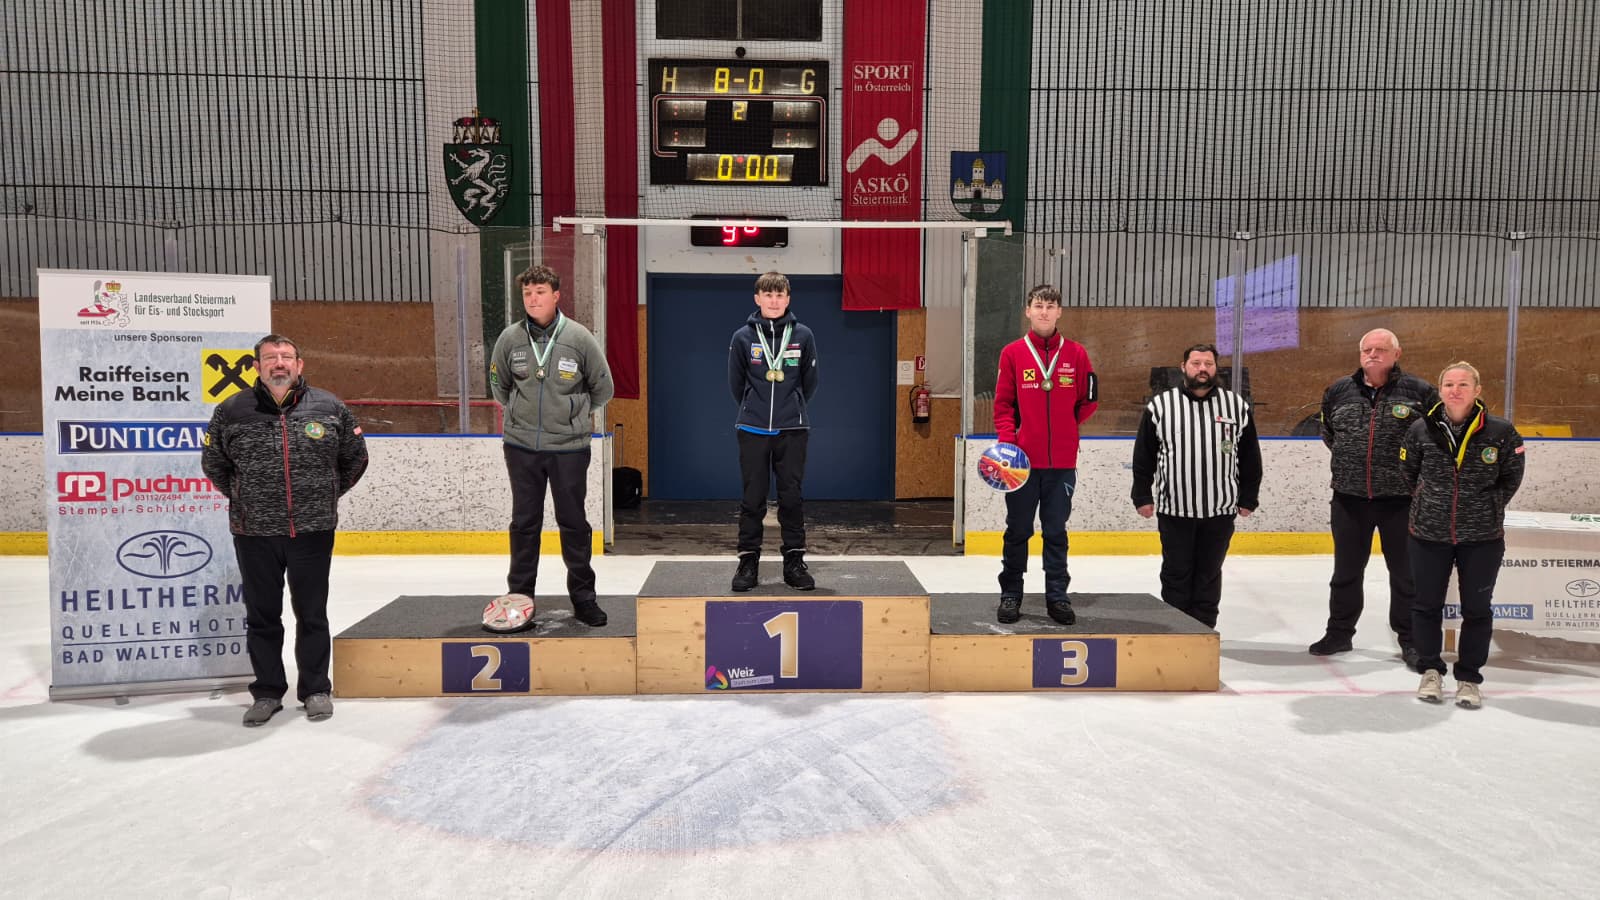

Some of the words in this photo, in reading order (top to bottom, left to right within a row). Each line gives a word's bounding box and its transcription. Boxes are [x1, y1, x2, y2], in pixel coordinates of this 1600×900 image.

[662, 67, 677, 92] H
[801, 69, 816, 94] G
[854, 65, 912, 80] SPORT
[854, 83, 862, 92] in
[866, 82, 910, 92] Österreich
[733, 102, 745, 120] 2
[853, 174, 909, 193] ASKÖ
[853, 194, 909, 205] Steiermark
[134, 292, 192, 304] Landesverband
[194, 294, 236, 305] Steiermark
[135, 305, 147, 316] für
[149, 306, 164, 316] Eis-
[167, 307, 181, 316] und
[183, 307, 224, 318] Stocksport
[114, 334, 147, 342] unsere
[150, 333, 202, 344] Sponsoren
[79, 366, 190, 383] Raiffeisen
[55, 386, 124, 401] Meine
[132, 386, 190, 402] Bank
[63, 650, 104, 664] BAD
[116, 642, 250, 661] WALTERSDO
[763, 612, 798, 678] 1
[470, 644, 502, 691] 2
[1061, 640, 1089, 686] 3
[728, 666, 755, 679] Weiz
